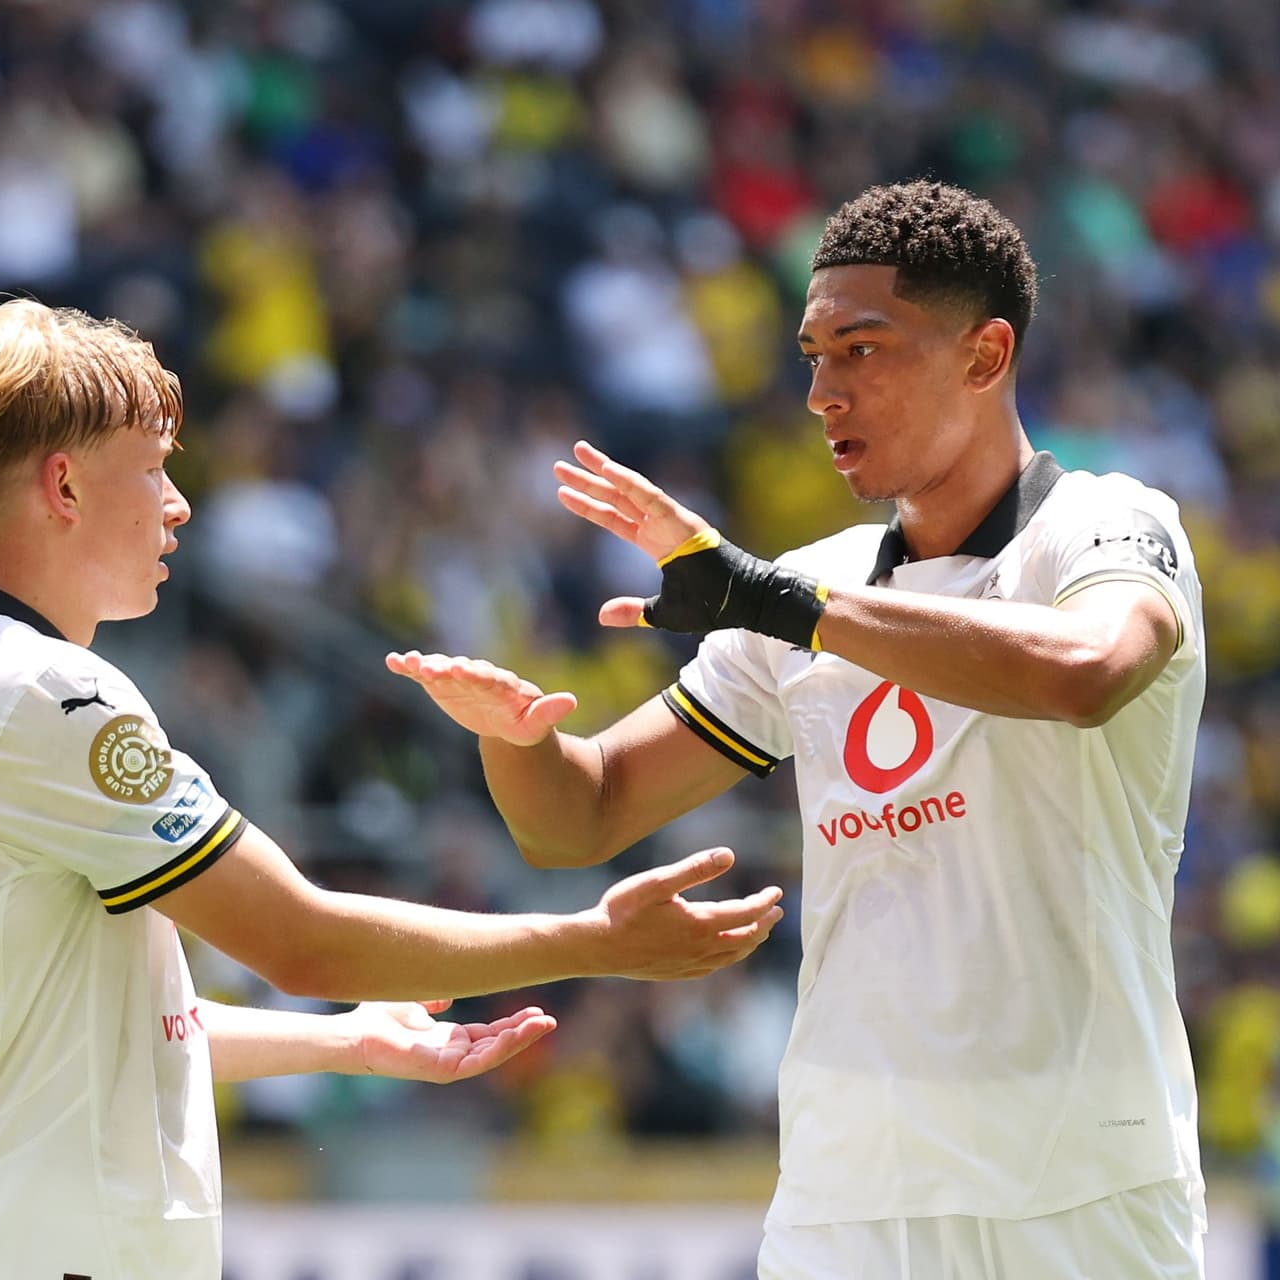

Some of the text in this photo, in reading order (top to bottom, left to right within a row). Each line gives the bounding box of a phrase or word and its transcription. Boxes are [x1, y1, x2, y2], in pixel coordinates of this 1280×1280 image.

[117, 722, 138, 734] CUP
[98, 732, 117, 775] WORLD
[105, 775, 133, 796] CLUB
[140, 769, 168, 798] FIFA
